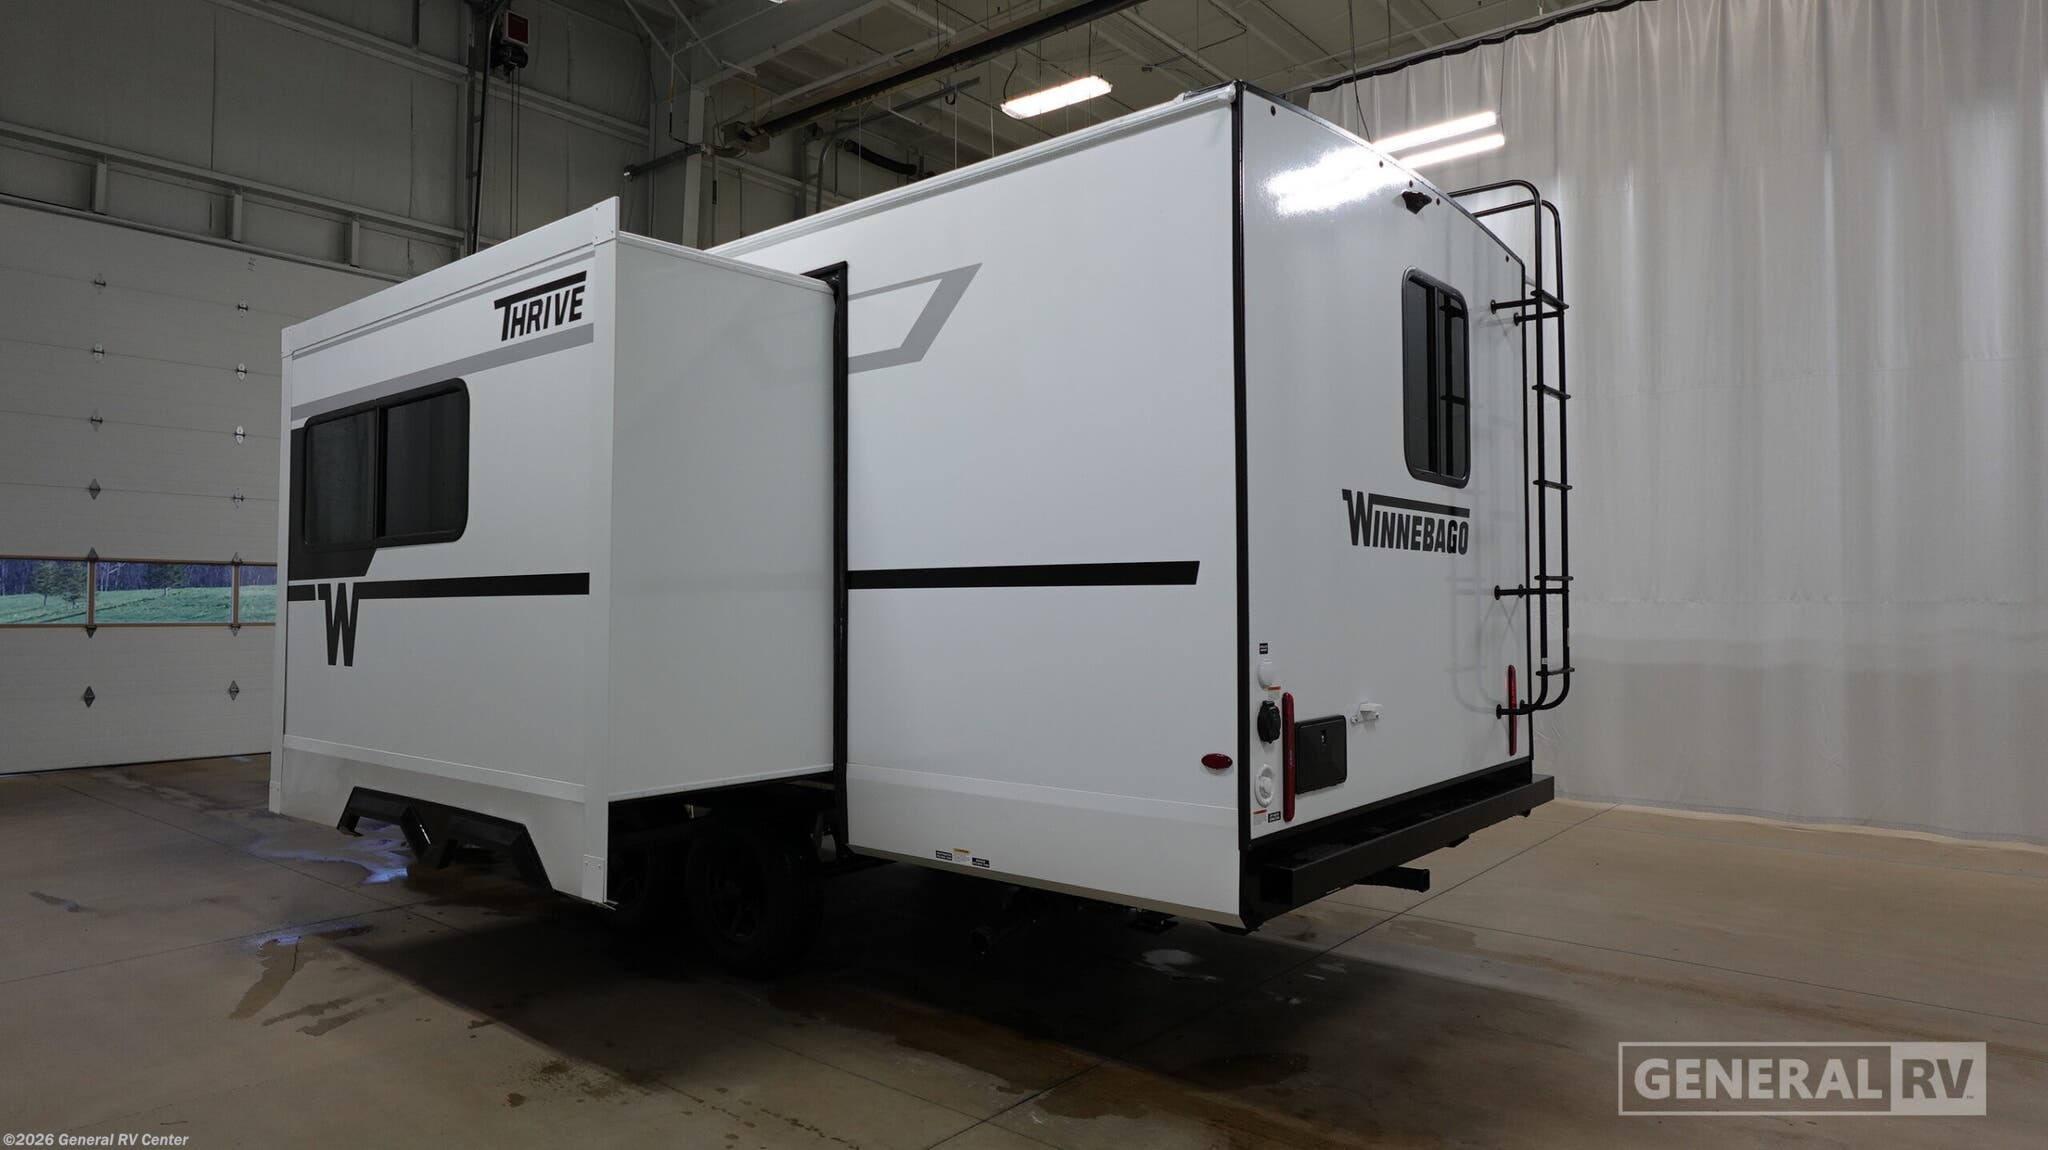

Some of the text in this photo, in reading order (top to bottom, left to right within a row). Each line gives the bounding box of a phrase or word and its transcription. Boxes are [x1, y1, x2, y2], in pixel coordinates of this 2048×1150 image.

[494, 270, 587, 341] THRIVE
[1342, 488, 1470, 555] WINNEBAGO
[318, 582, 359, 667] W
